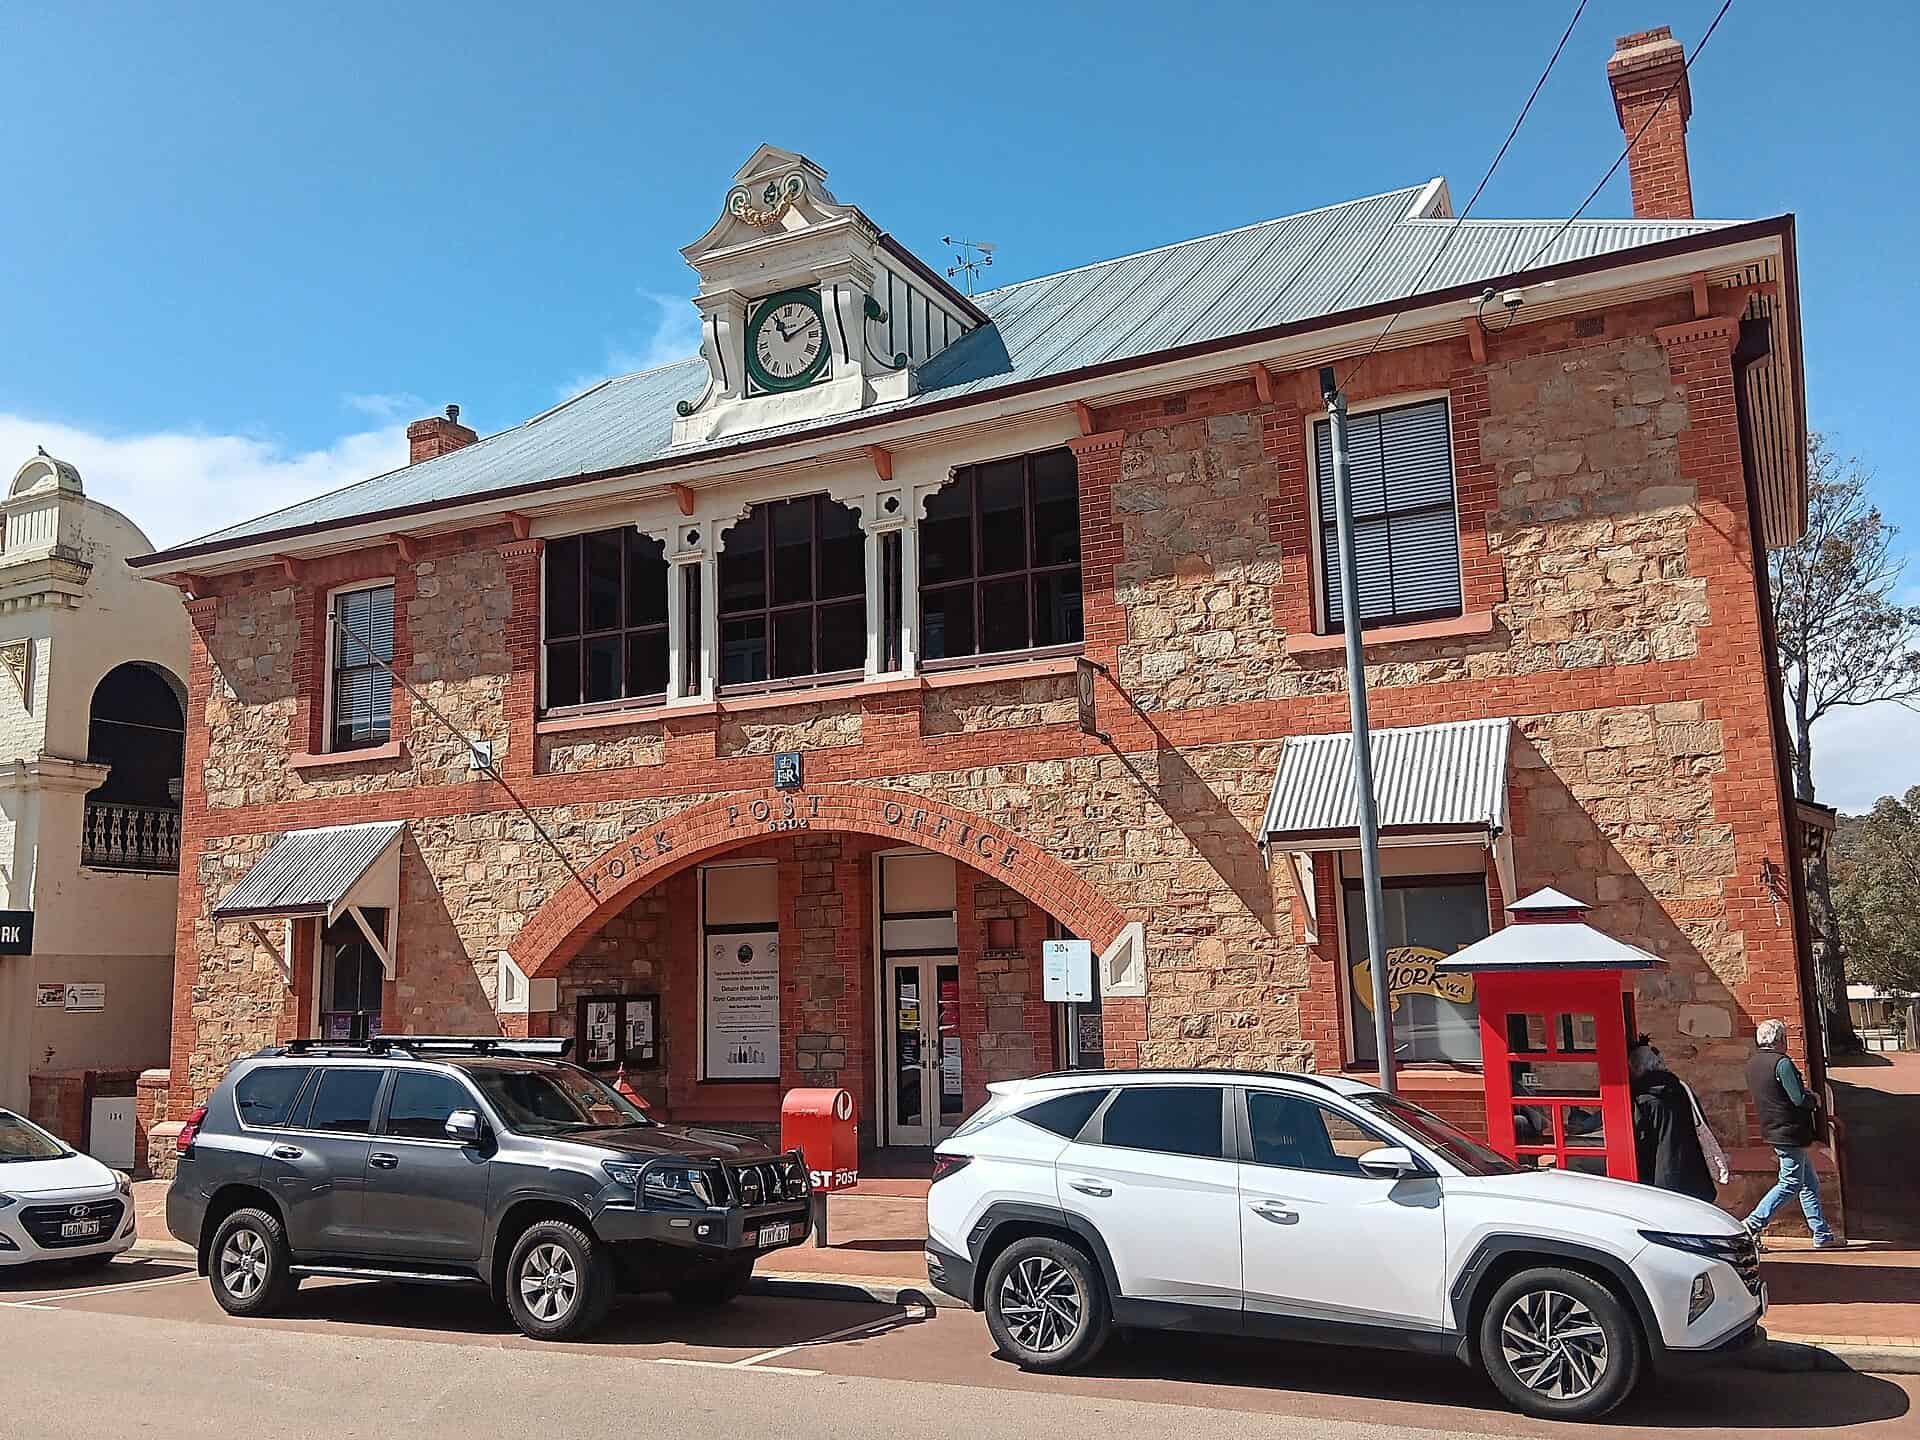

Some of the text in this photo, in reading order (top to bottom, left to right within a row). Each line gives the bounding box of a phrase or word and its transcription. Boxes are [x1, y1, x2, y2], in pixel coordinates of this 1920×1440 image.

[585, 796, 1020, 895] YORK POST OFFICE
[1388, 967, 1447, 992] YORK
[1446, 982, 1465, 995] WA
[810, 1170, 832, 1187] ST
[835, 1170, 858, 1186] POST
